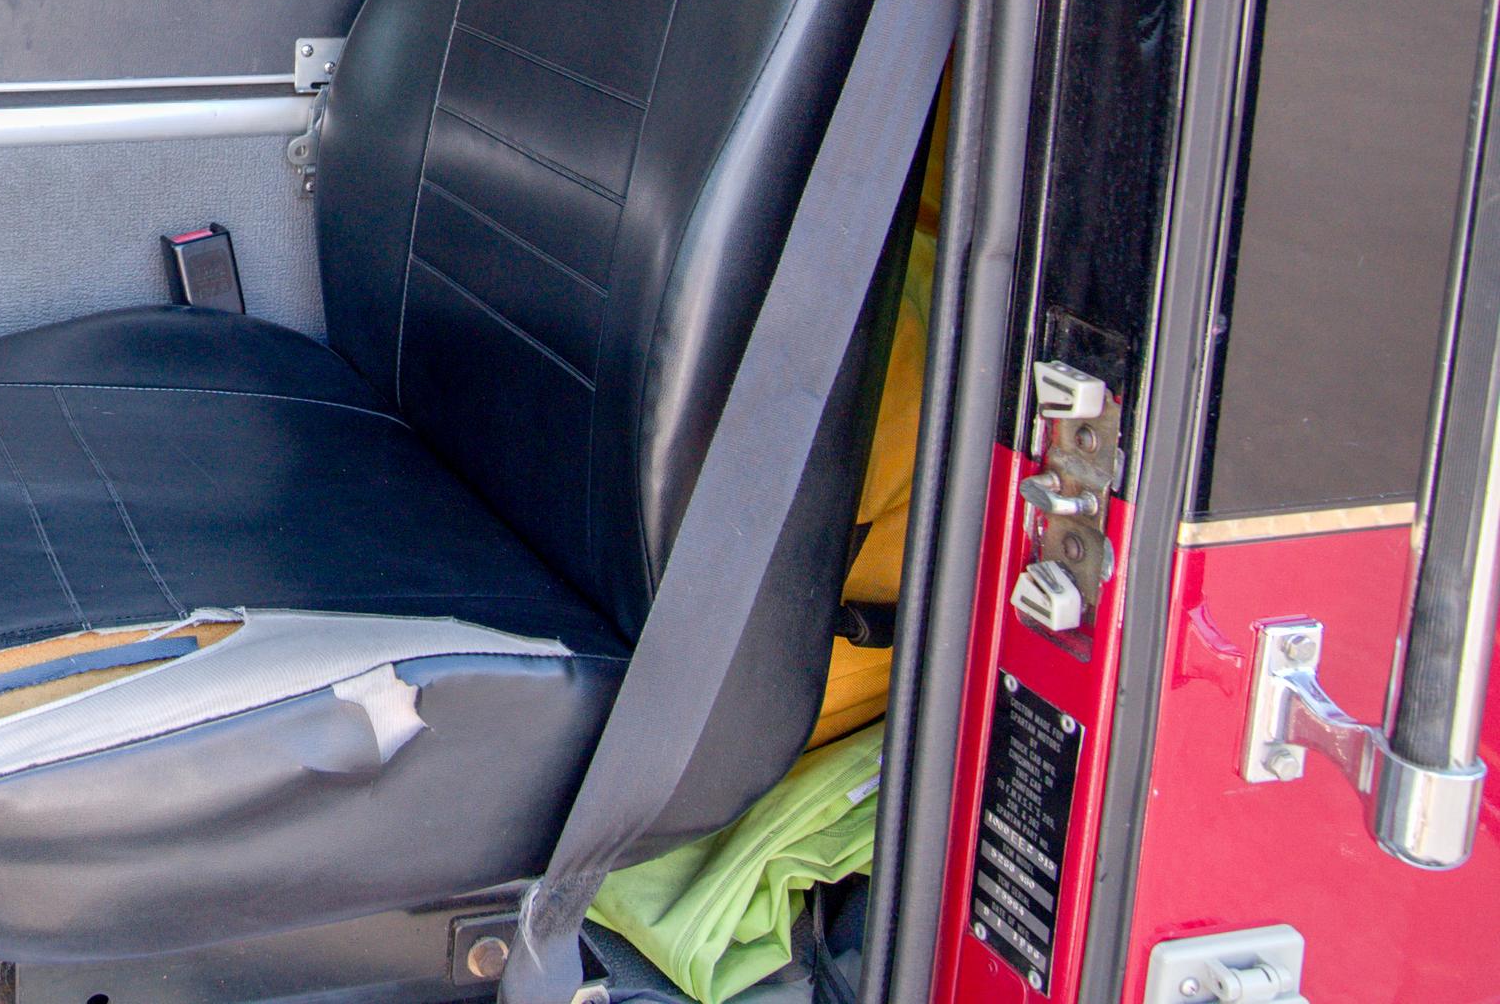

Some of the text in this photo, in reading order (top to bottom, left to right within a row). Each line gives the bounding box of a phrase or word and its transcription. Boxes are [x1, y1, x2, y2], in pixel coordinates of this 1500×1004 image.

[1010, 696, 1064, 742] CUSTOM MADE FOR
[1010, 709, 1061, 753] SPARTAN MOTORS
[1010, 735, 1028, 754] TRUCK
[1029, 750, 1042, 765] CAB
[1029, 737, 1038, 749] BY
[1016, 766, 1029, 782] THIS
[1011, 776, 1042, 806] CONFORMS
[996, 803, 1022, 830] SPARTAN
[1022, 824, 1038, 842] PART
[1011, 885, 1030, 908] SERIAL
